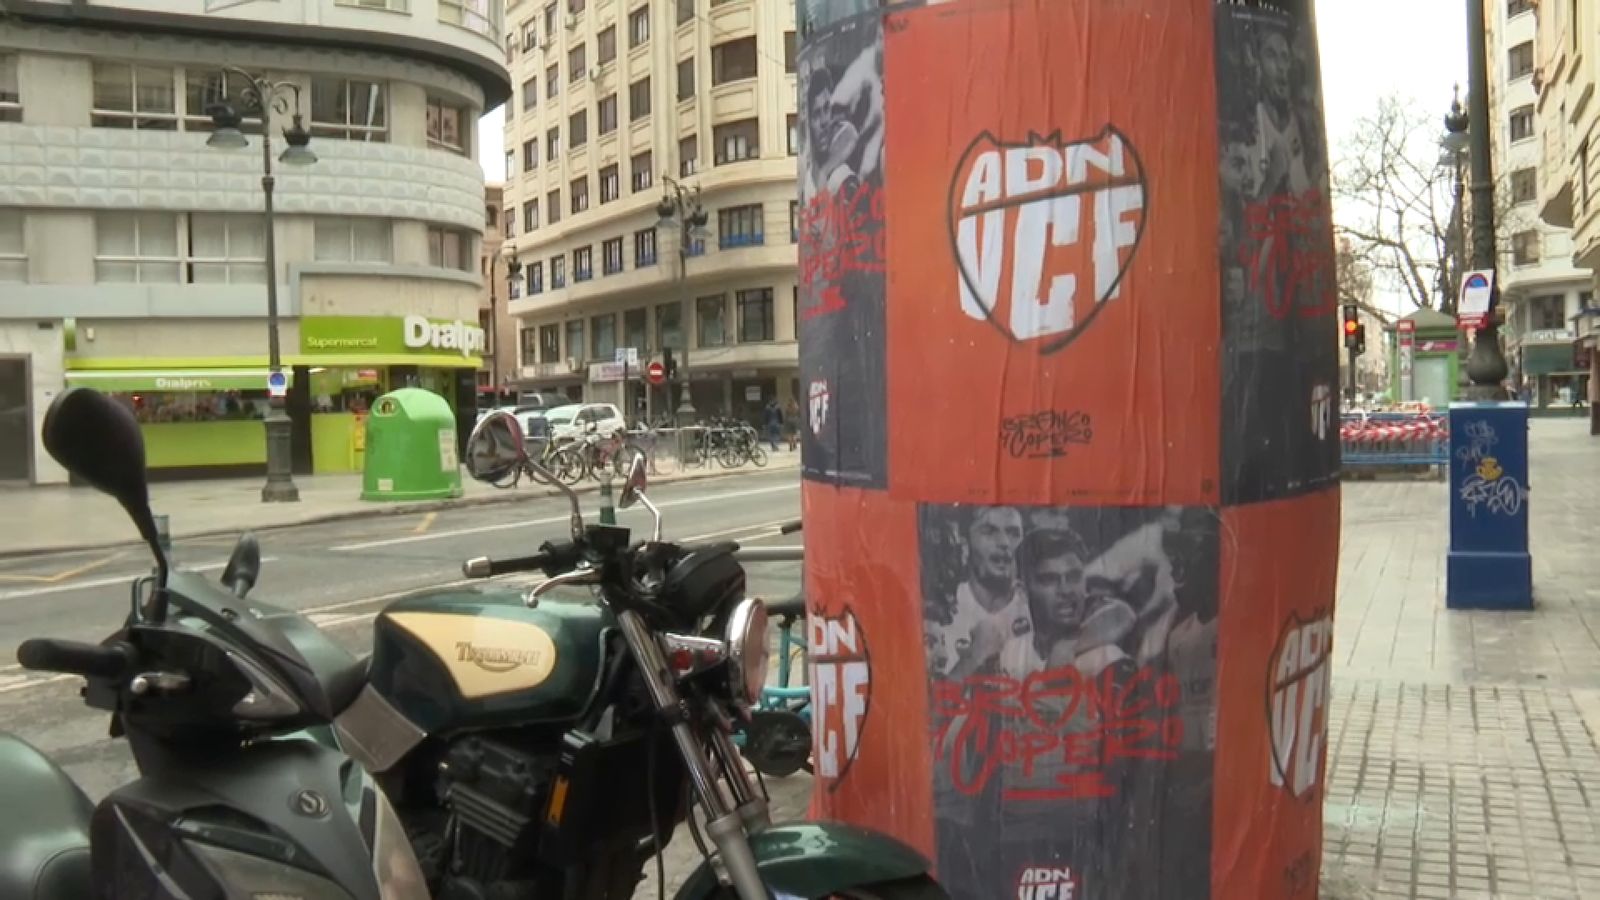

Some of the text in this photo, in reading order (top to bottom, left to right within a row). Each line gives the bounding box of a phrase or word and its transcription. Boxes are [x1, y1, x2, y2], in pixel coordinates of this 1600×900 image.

[962, 134, 1124, 208] ADN
[957, 184, 1143, 340] VCF
[307, 336, 377, 349] Supermercat
[808, 611, 857, 656] DN
[934, 664, 1182, 738] BRONCO
[951, 713, 1185, 795] COPERO
[1021, 867, 1071, 884] ADN
